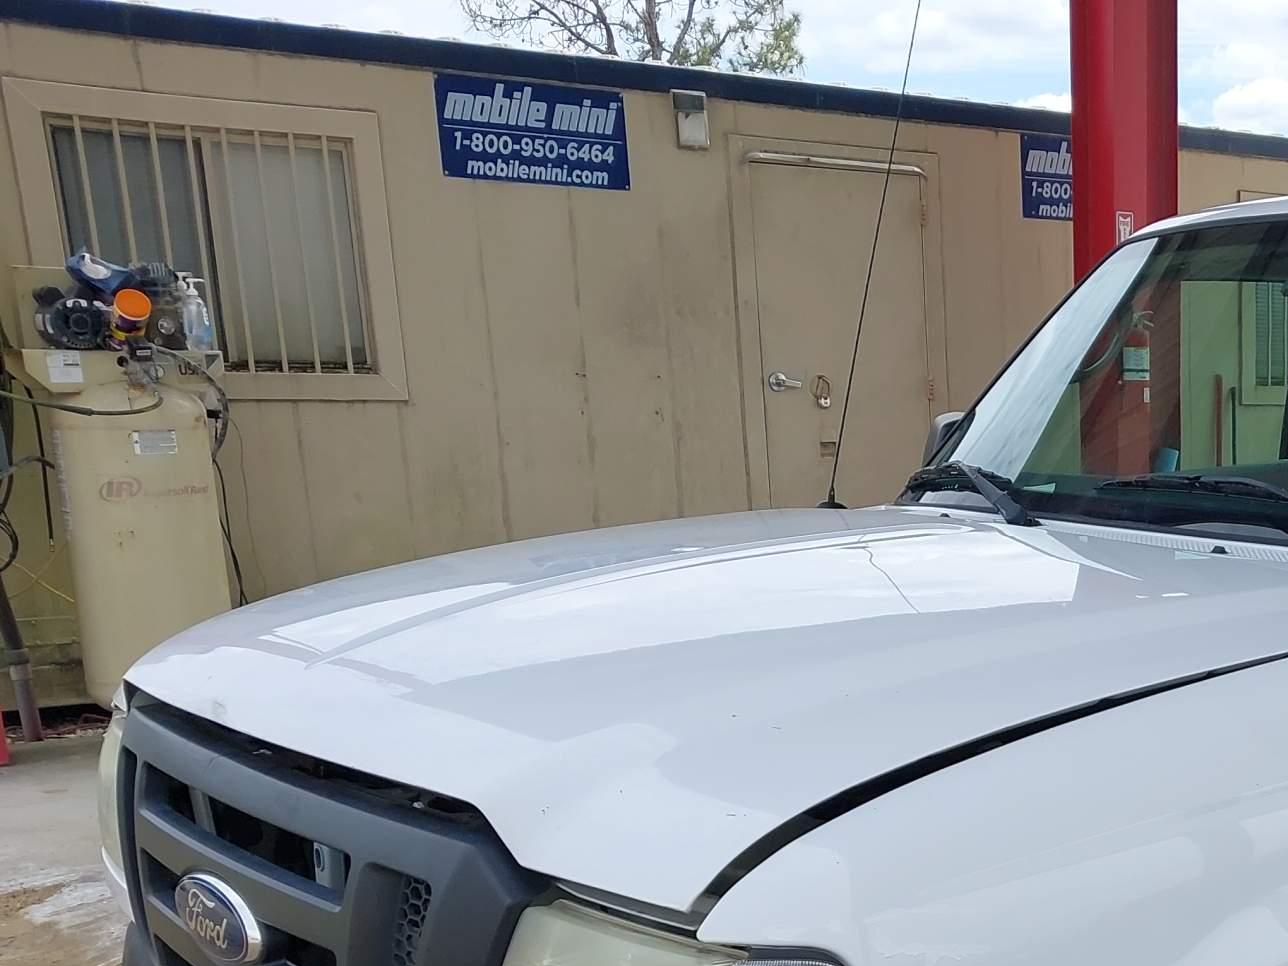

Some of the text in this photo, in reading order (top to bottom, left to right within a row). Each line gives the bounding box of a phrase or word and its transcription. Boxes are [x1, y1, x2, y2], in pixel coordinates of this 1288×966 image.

[444, 83, 618, 135] mobile mini
[454, 131, 615, 164] 1-800-950-6464
[1025, 141, 1072, 175] mob
[466, 159, 609, 185] mobilemini.com
[185, 888, 229, 949] Ford
